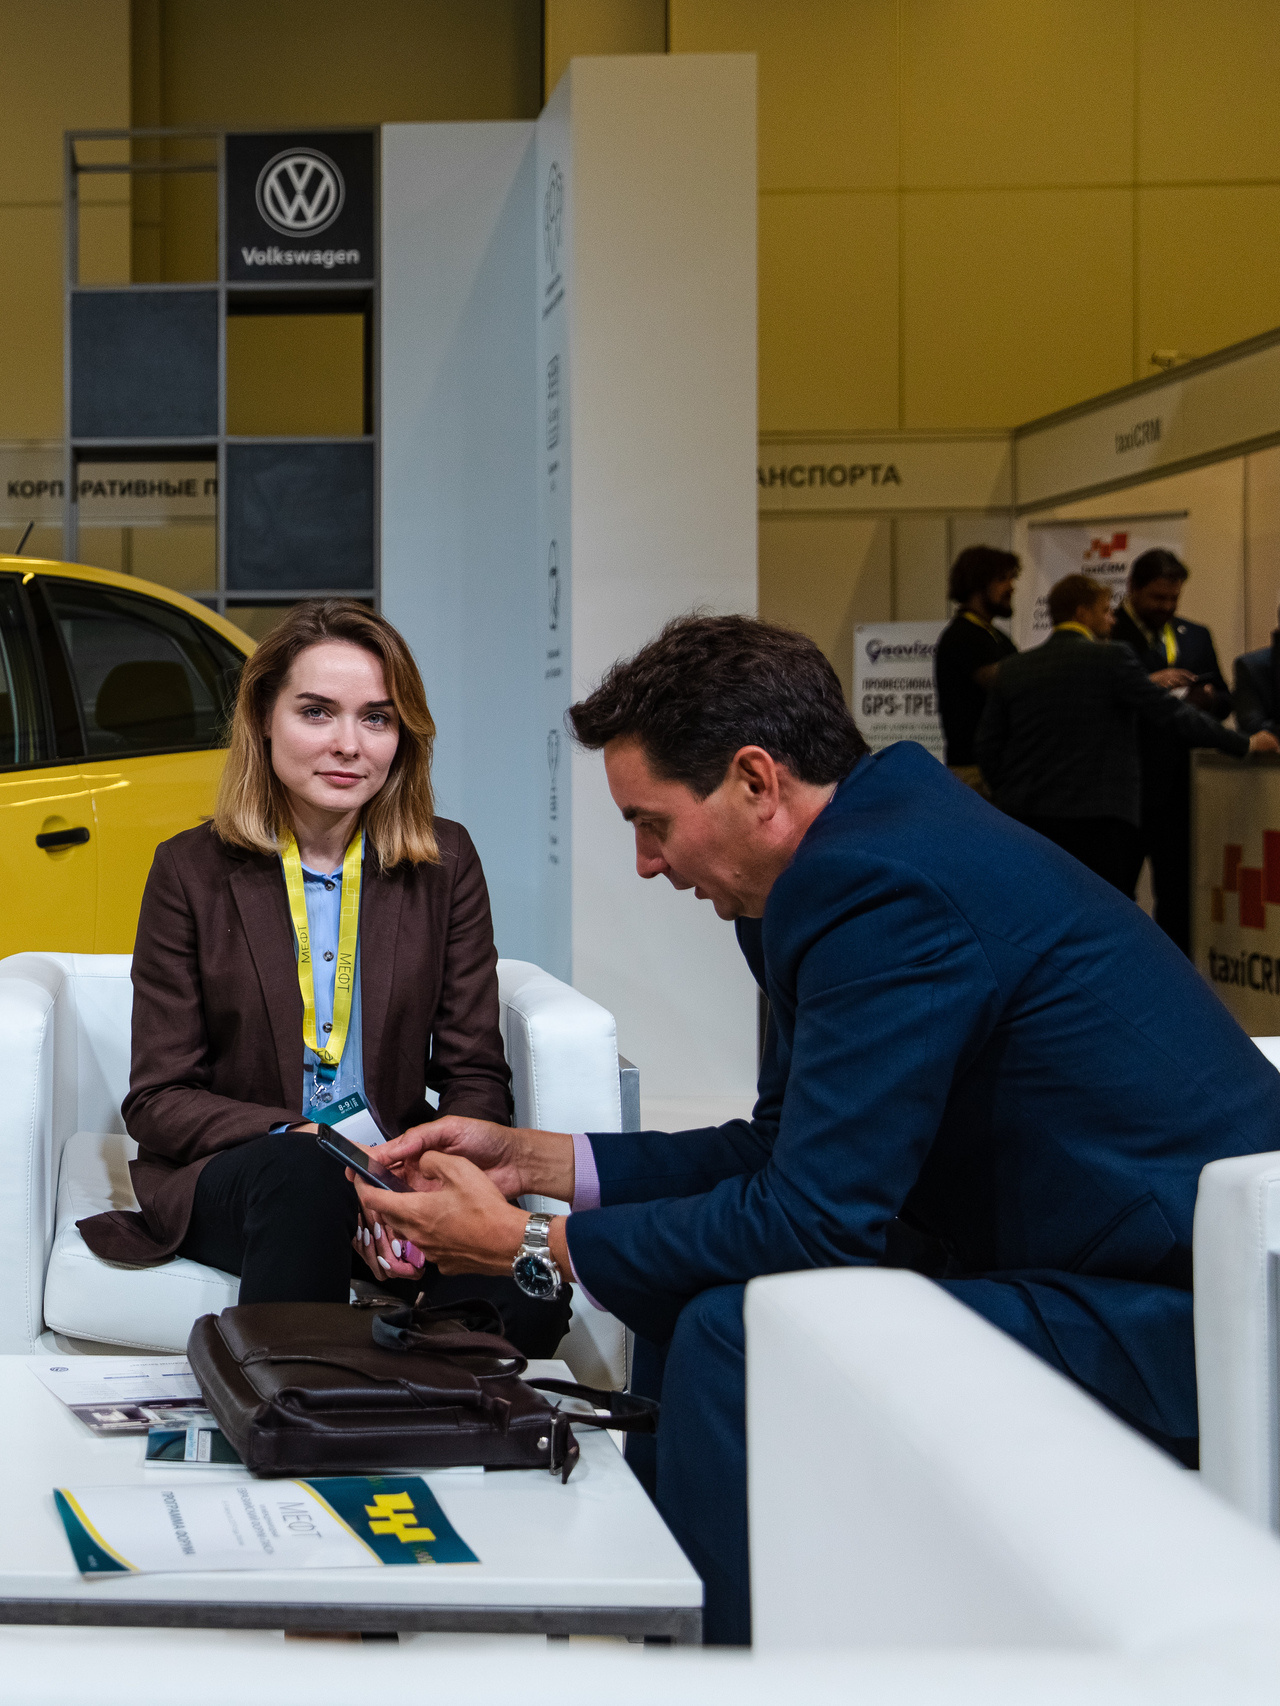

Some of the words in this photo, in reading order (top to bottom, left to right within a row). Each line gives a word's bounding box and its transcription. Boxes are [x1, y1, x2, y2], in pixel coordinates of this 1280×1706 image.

[241, 246, 360, 268] Volkswagen
[7, 478, 197, 498] КОРПРАТИВНЫЕ
[862, 678, 936, 691] ПРОФЕССИОНА
[861, 693, 937, 716] GPS-ТРЕ
[298, 924, 310, 963] МЕФТ
[337, 952, 352, 993] МЕФТ
[338, 1101, 350, 1111] 8-9
[276, 1501, 323, 1538] МЕФТ
